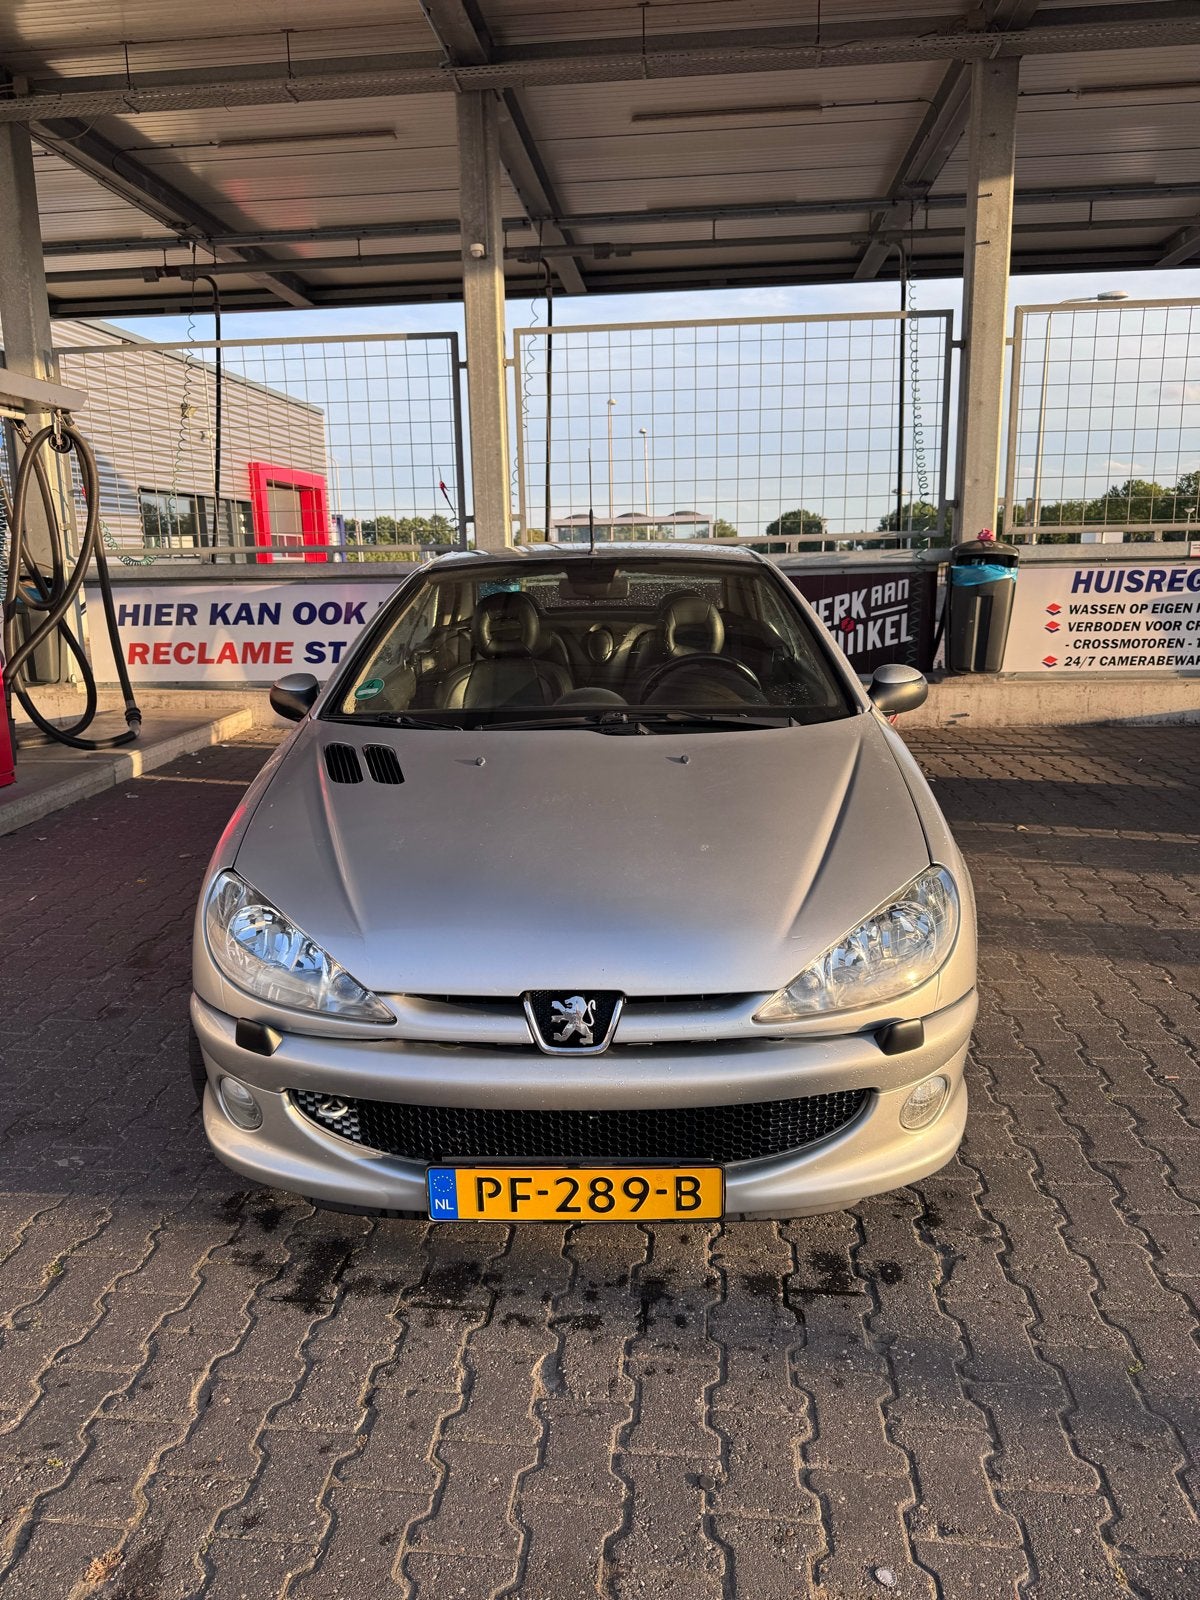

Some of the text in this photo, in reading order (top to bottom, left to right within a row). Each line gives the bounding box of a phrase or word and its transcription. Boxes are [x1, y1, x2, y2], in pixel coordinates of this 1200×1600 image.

[1071, 569, 1200, 593] HUISREG
[118, 601, 367, 626] HIER KAN OOK
[1068, 603, 1126, 614] WASSEN
[1129, 603, 1148, 614] OP
[1151, 603, 1193, 614] EIGEN
[1067, 621, 1141, 632] VERBODEN
[1145, 620, 1182, 631] VOOR
[1073, 638, 1185, 649] CROSSMOTOREN
[128, 640, 347, 665] RECLAME ST
[1064, 656, 1096, 668] 24/7
[476, 1176, 703, 1213] PF-289-B
[434, 1198, 454, 1210] NL
